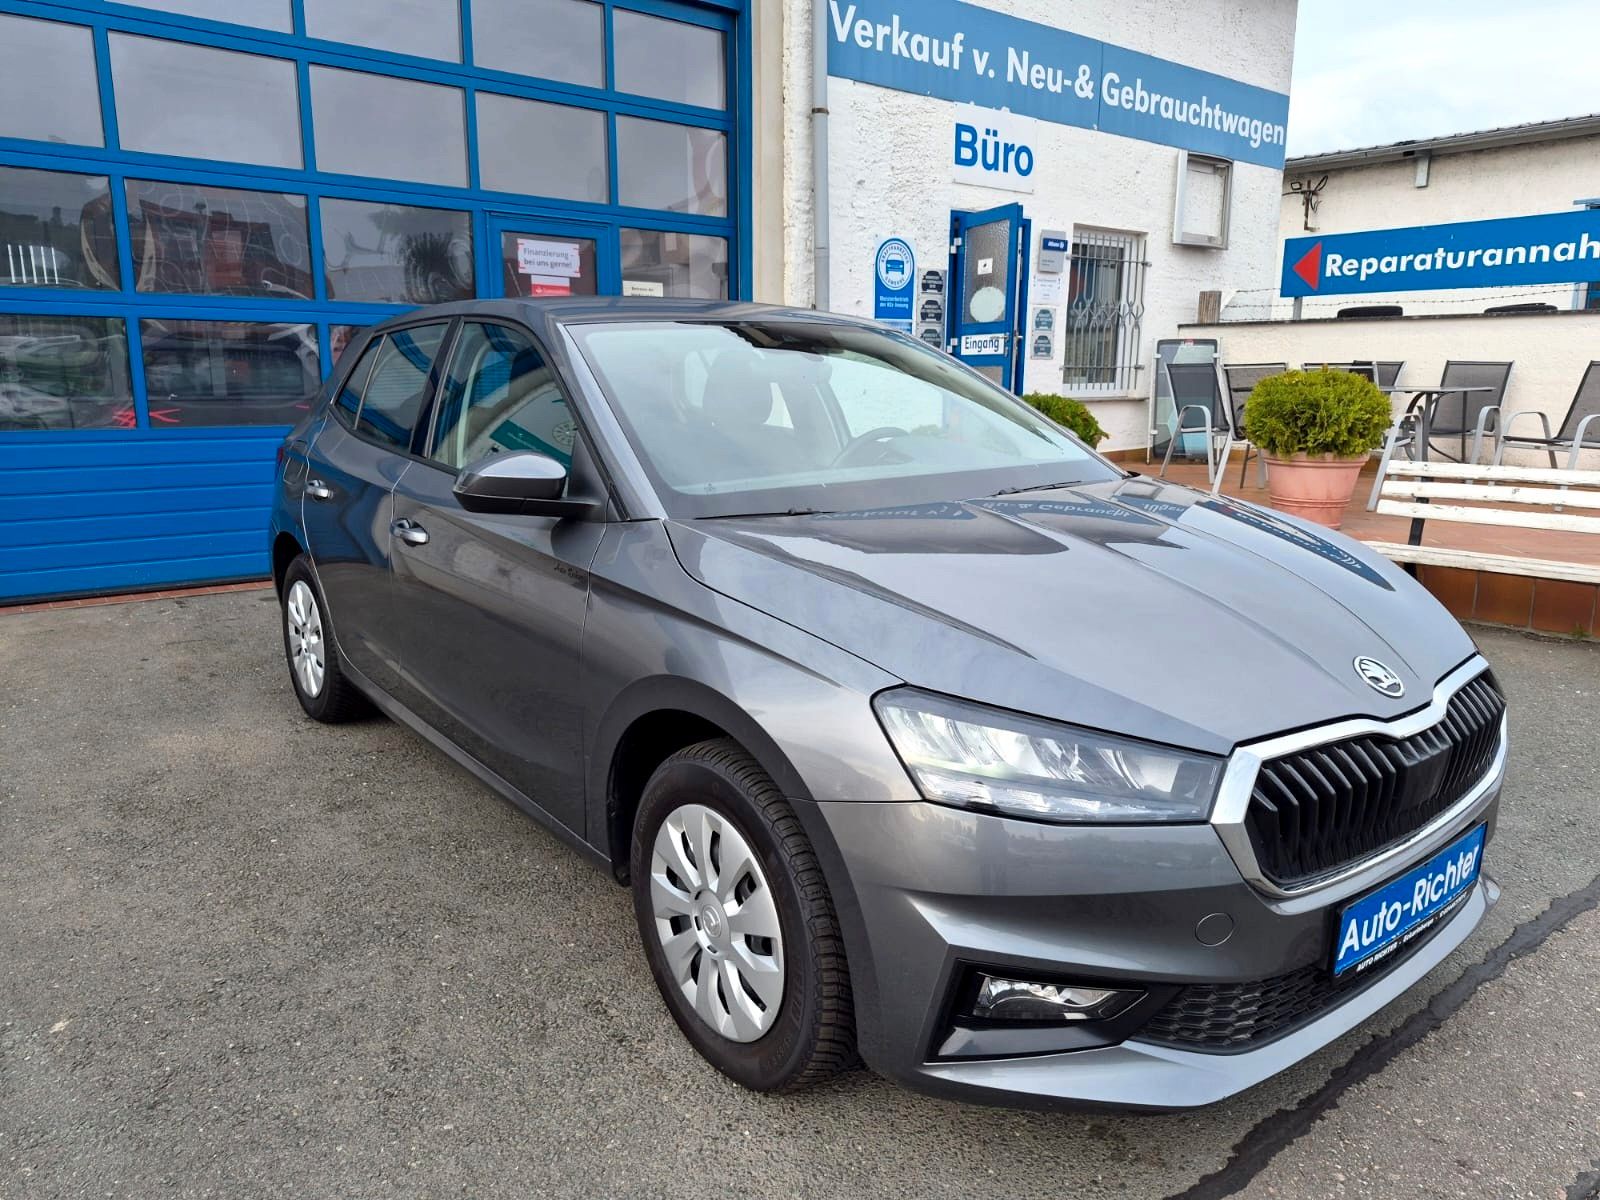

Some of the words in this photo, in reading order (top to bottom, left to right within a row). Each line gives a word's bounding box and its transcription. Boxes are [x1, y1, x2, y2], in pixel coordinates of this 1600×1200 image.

[829, 0, 965, 70] Verkauf
[972, 48, 995, 79] v.
[1101, 72, 1285, 148] Gebrauchtwagen
[954, 122, 1034, 177] Büro
[523, 247, 569, 260] Finanzierung
[536, 259, 549, 267] uns
[1325, 232, 1600, 281] Reparaturannah
[964, 337, 1000, 353] Eingang
[1337, 844, 1480, 961] Auto-Richter
